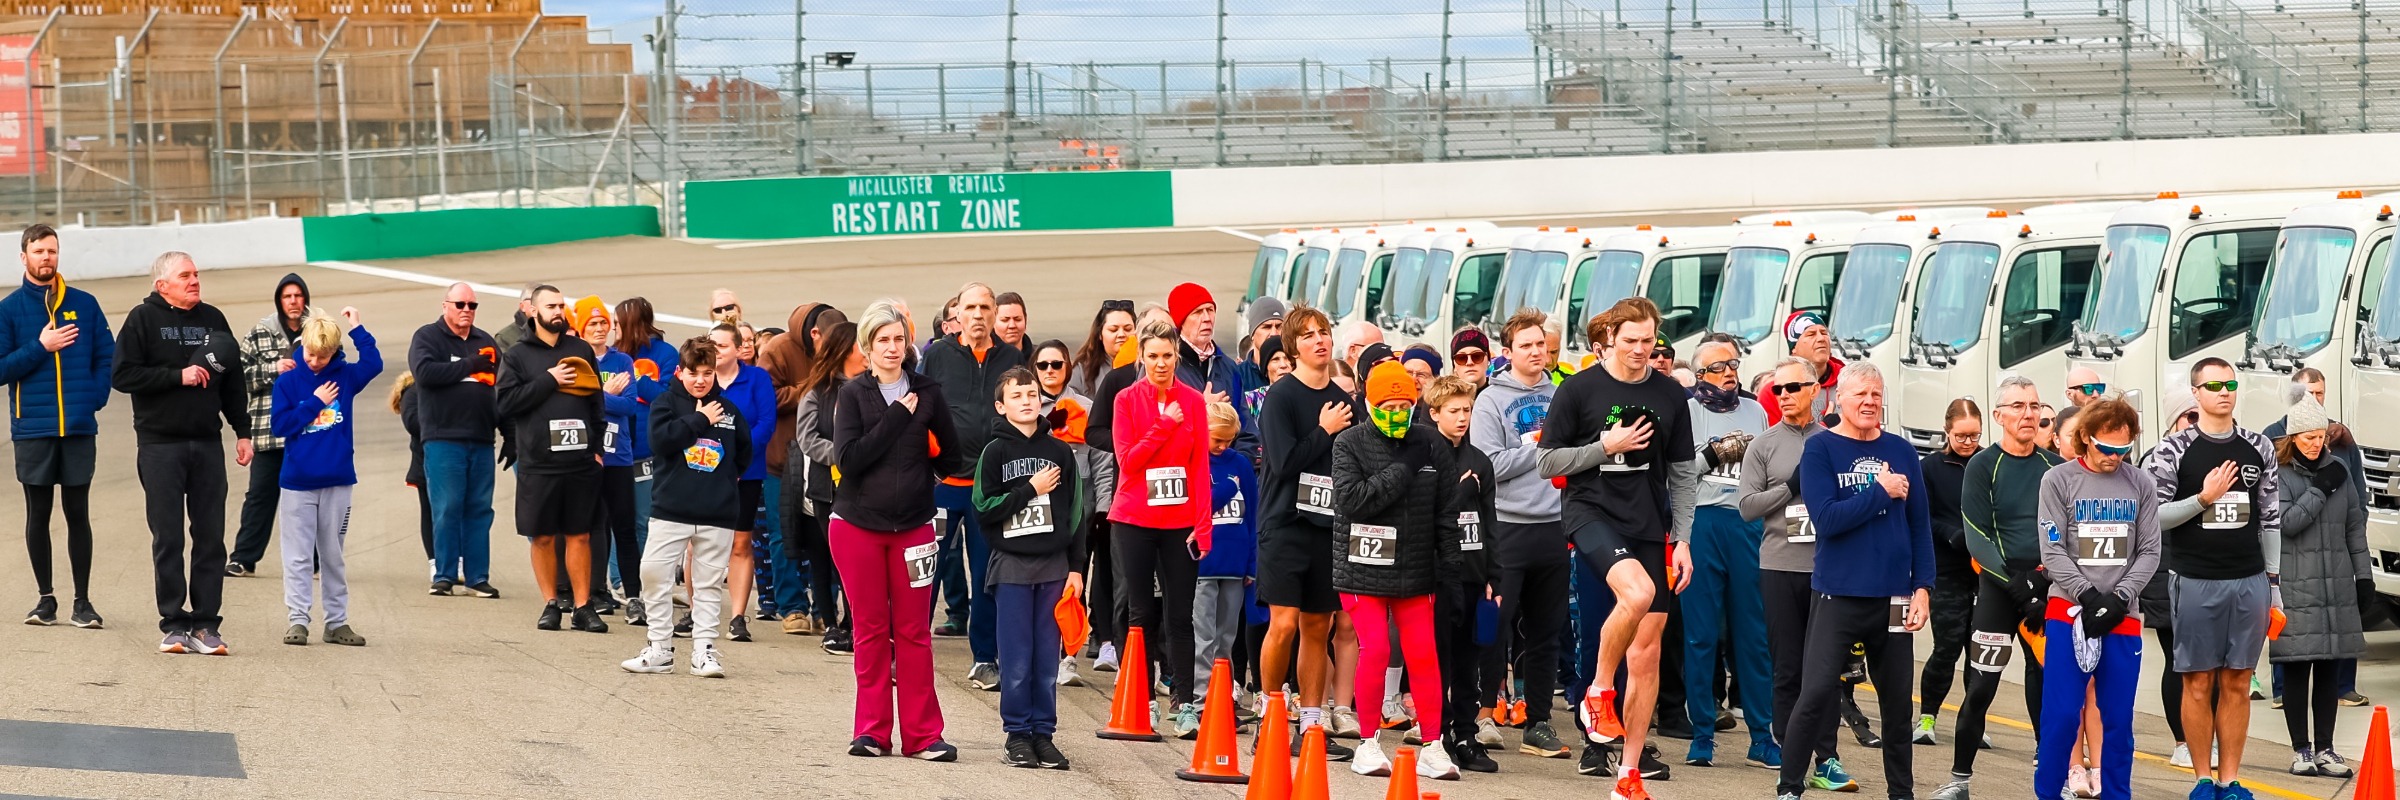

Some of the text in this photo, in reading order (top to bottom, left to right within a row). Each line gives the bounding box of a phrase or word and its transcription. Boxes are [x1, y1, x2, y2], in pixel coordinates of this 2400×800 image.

[849, 175, 1006, 196] MACALLISTER RENTALS
[832, 199, 1021, 233] RESTART ZONE
[560, 429, 579, 445] 28
[603, 431, 613, 447] 0
[641, 461, 653, 476] 6
[1154, 478, 1184, 499] 110
[1309, 486, 1332, 508] 60
[1010, 505, 1045, 530] 123
[2075, 498, 2137, 523] MICHIGAN
[2215, 503, 2238, 523] 55
[1460, 524, 1479, 543] 18
[1359, 537, 1383, 558] 62
[2092, 537, 2116, 559] 74
[915, 553, 938, 580] 12
[1979, 633, 1990, 641] ERIK
[1978, 645, 2002, 666] 77
